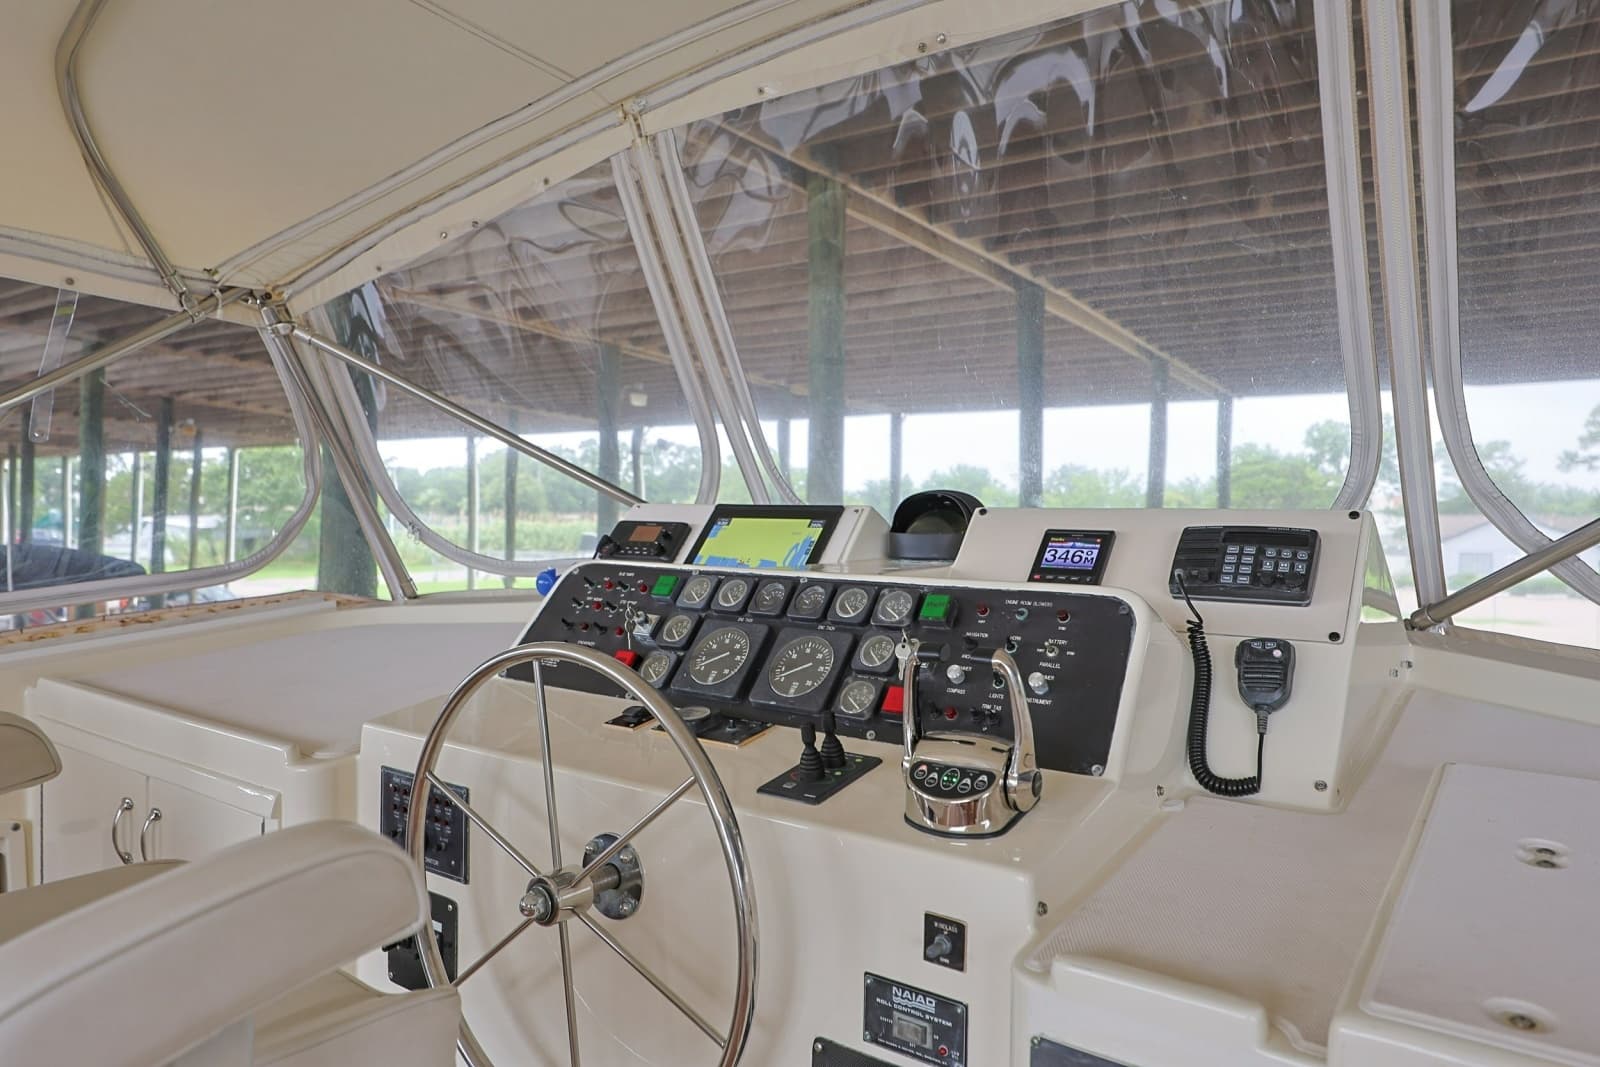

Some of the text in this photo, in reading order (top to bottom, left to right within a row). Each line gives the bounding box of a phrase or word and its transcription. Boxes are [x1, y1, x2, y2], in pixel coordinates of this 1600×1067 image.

[892, 986, 936, 1007] NAIAD
[876, 997, 953, 1028] ROLL CONTROL SYSTEM
